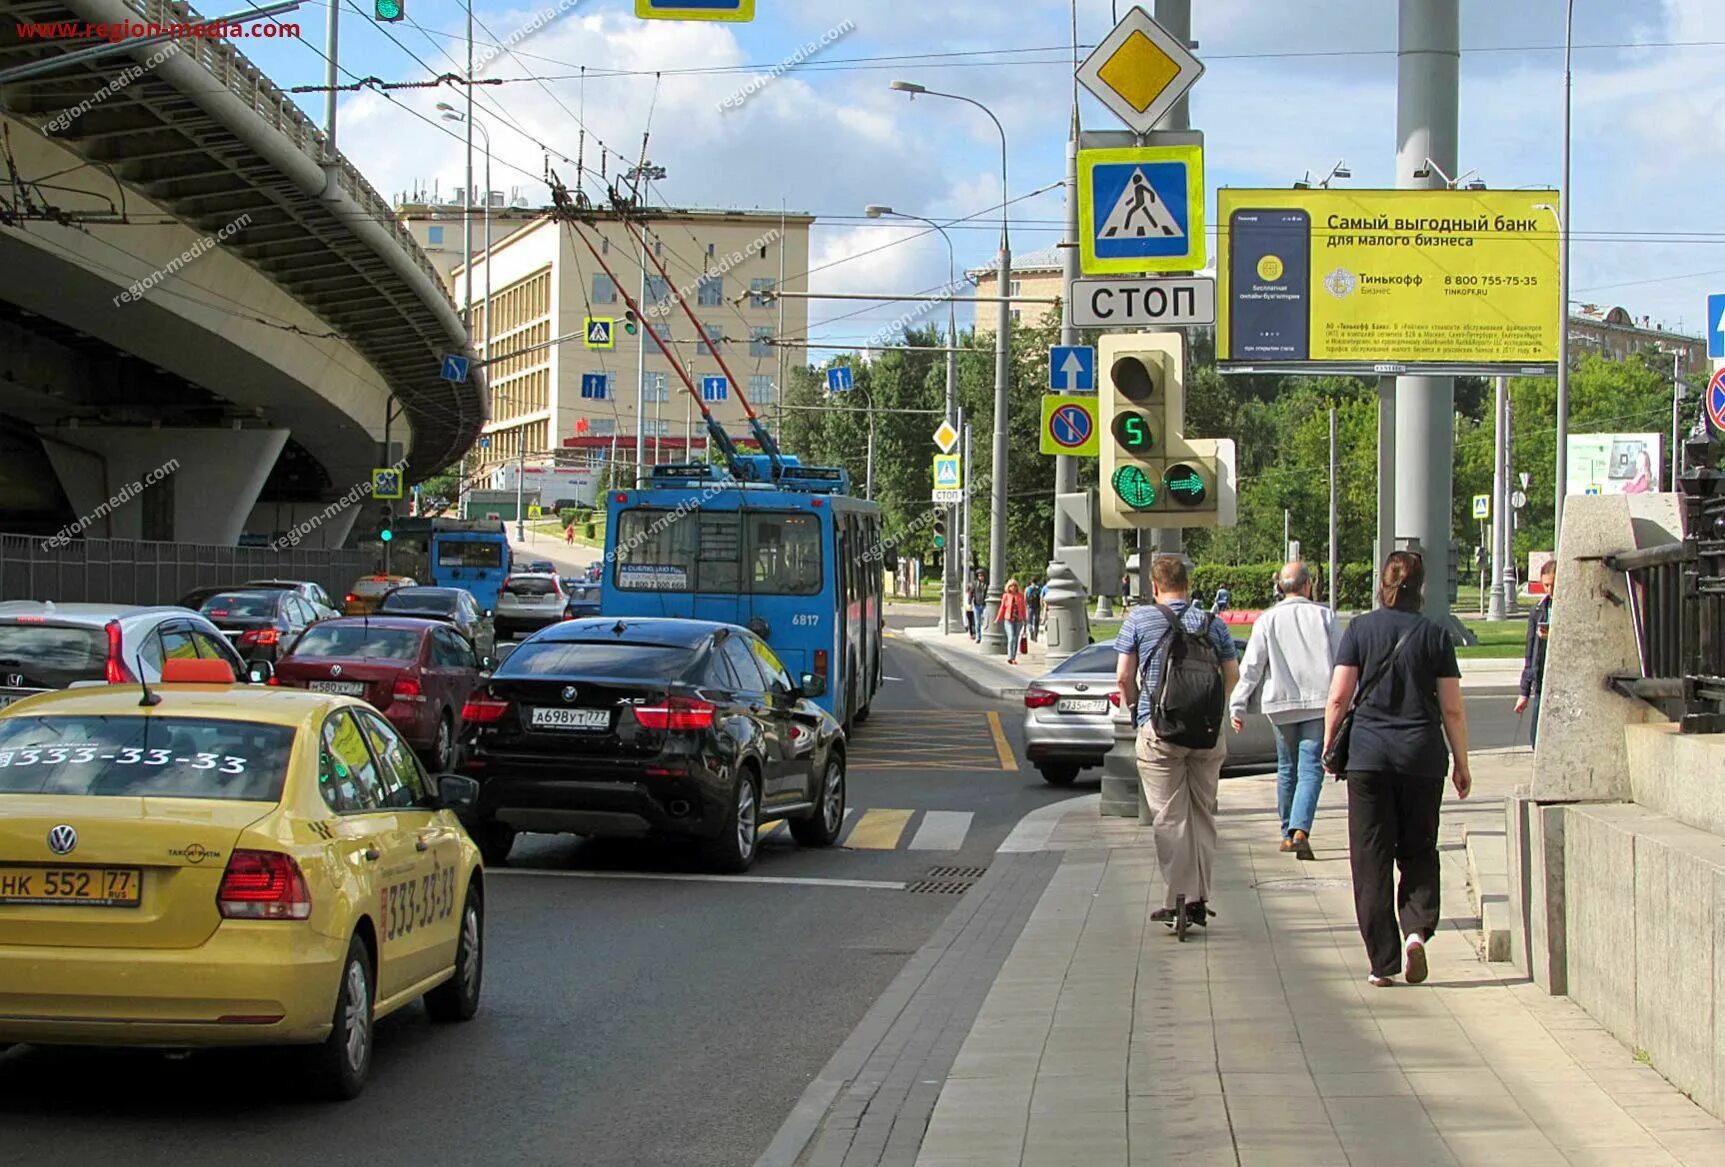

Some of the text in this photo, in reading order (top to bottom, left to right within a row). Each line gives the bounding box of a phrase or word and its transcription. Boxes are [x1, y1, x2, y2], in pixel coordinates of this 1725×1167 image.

[1327, 214, 1537, 233] Самый выгодный банк
[1327, 234, 1473, 249] для малого бизнеса
[1359, 273, 1423, 287] Тинькофф
[1444, 275, 1538, 286] 8 800 755-75-35
[1360, 287, 1391, 295] Бизнес
[1091, 286, 1195, 319] СТОП
[935, 491, 959, 500] СТОП
[791, 614, 819, 626] 6817
[536, 710, 607, 724] А698УТ 777
[15, 747, 248, 774] 333-33-33
[1, 871, 132, 897] НК 552 77
[388, 865, 455, 941] 333-33-33
